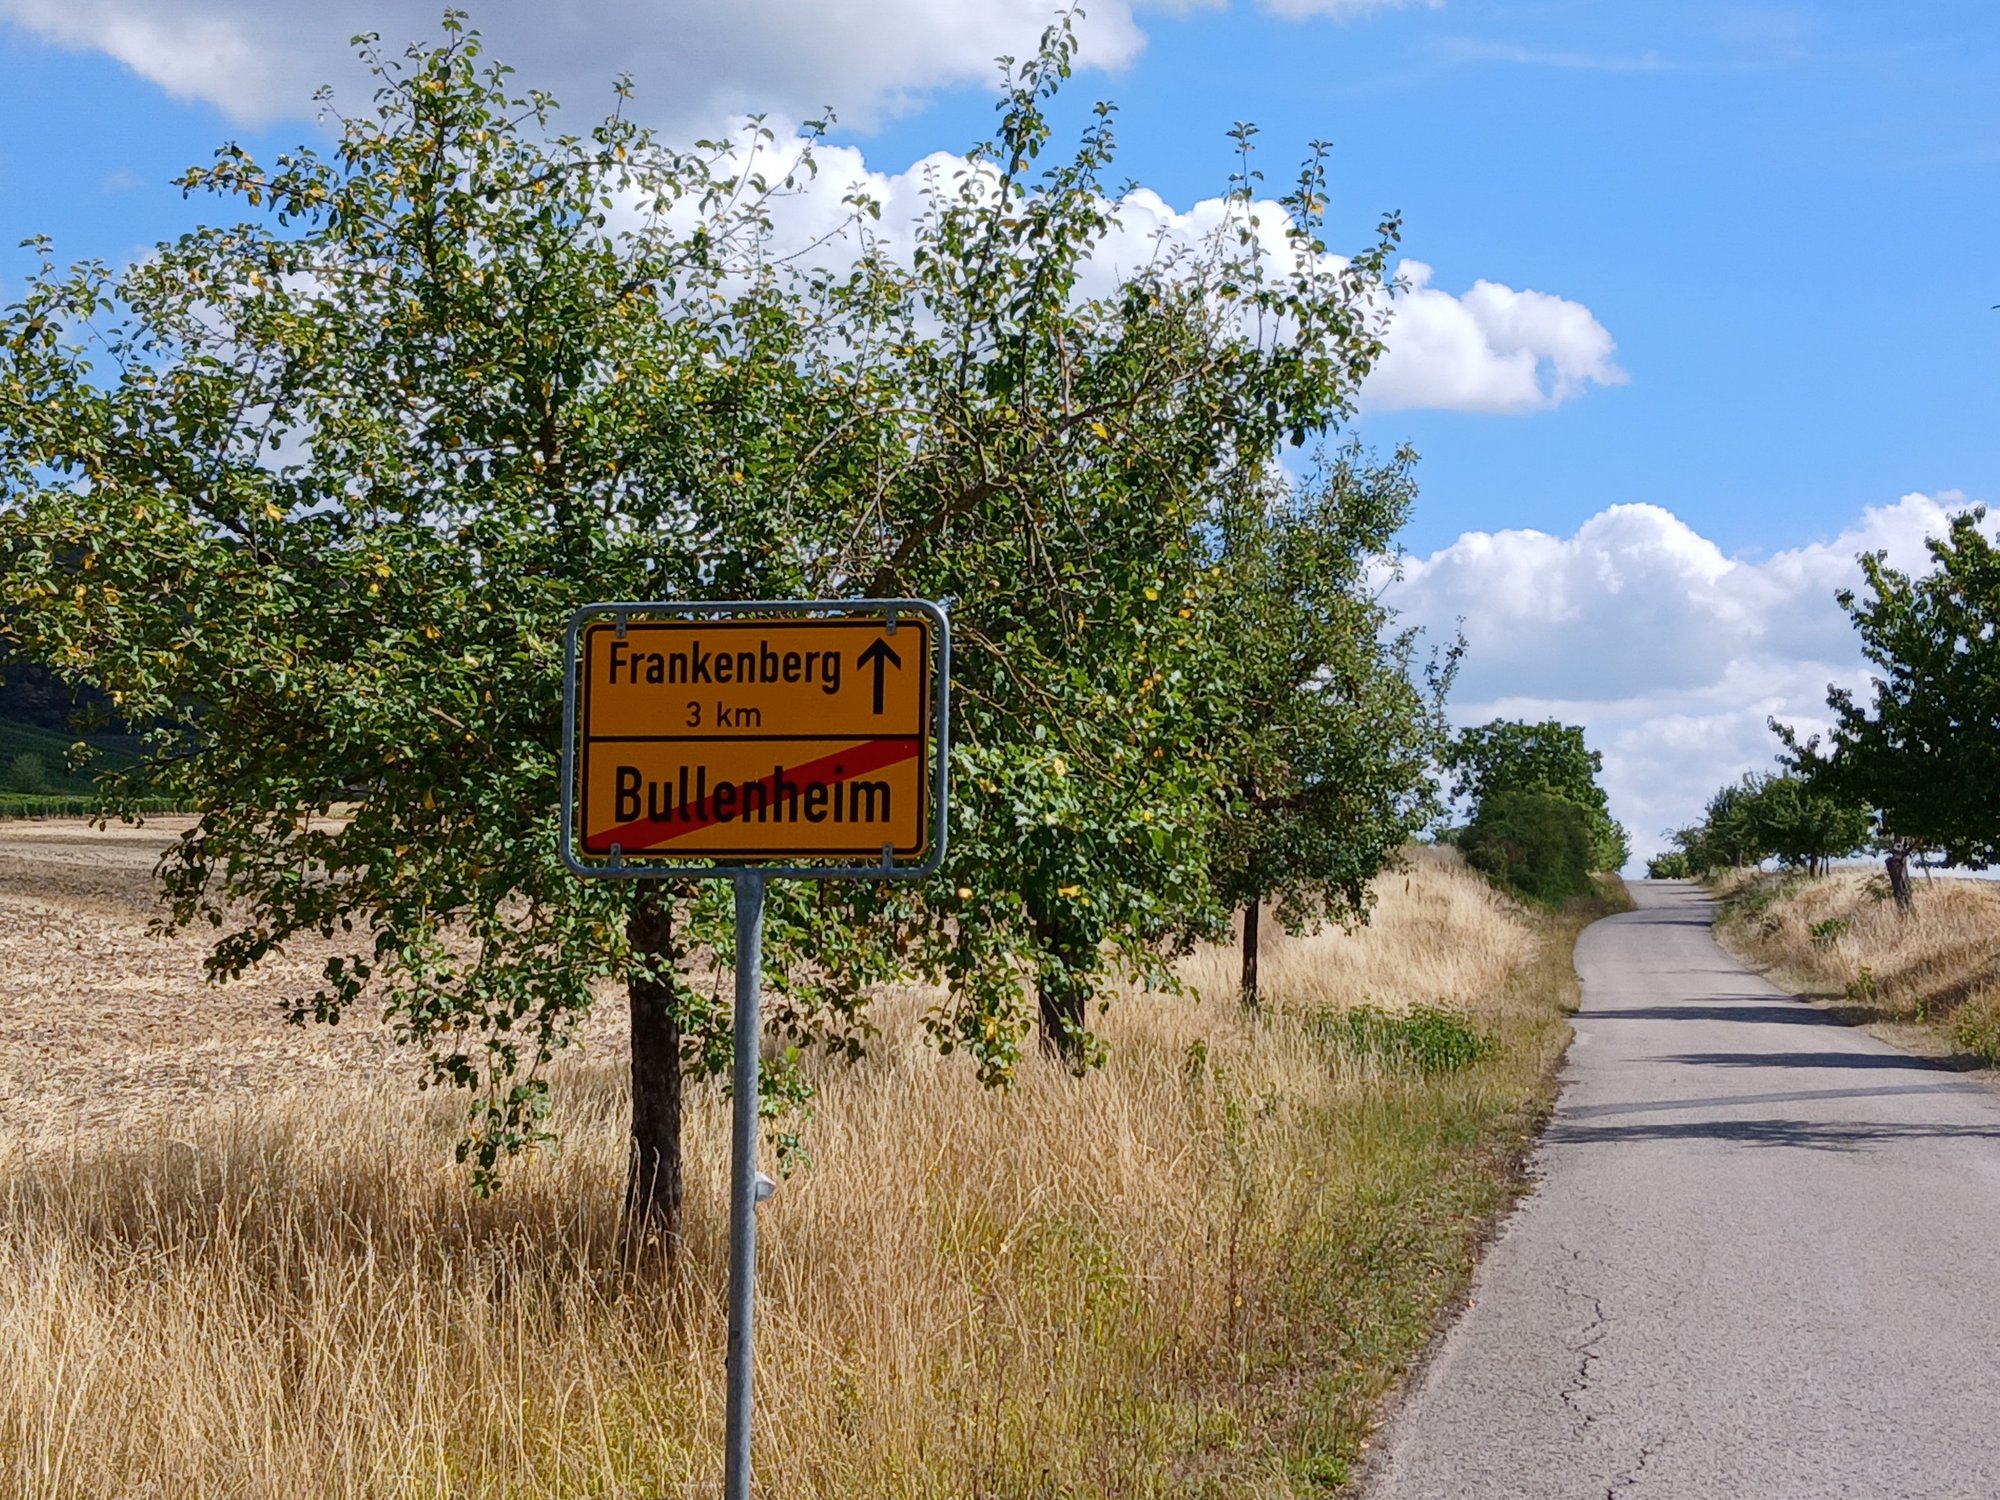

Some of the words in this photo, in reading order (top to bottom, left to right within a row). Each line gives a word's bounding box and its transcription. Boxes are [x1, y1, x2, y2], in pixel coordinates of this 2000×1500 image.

[609, 640, 841, 695] Frankenberg
[686, 702, 701, 728] 3
[716, 701, 761, 728] km
[614, 765, 891, 823] Bullenheim
